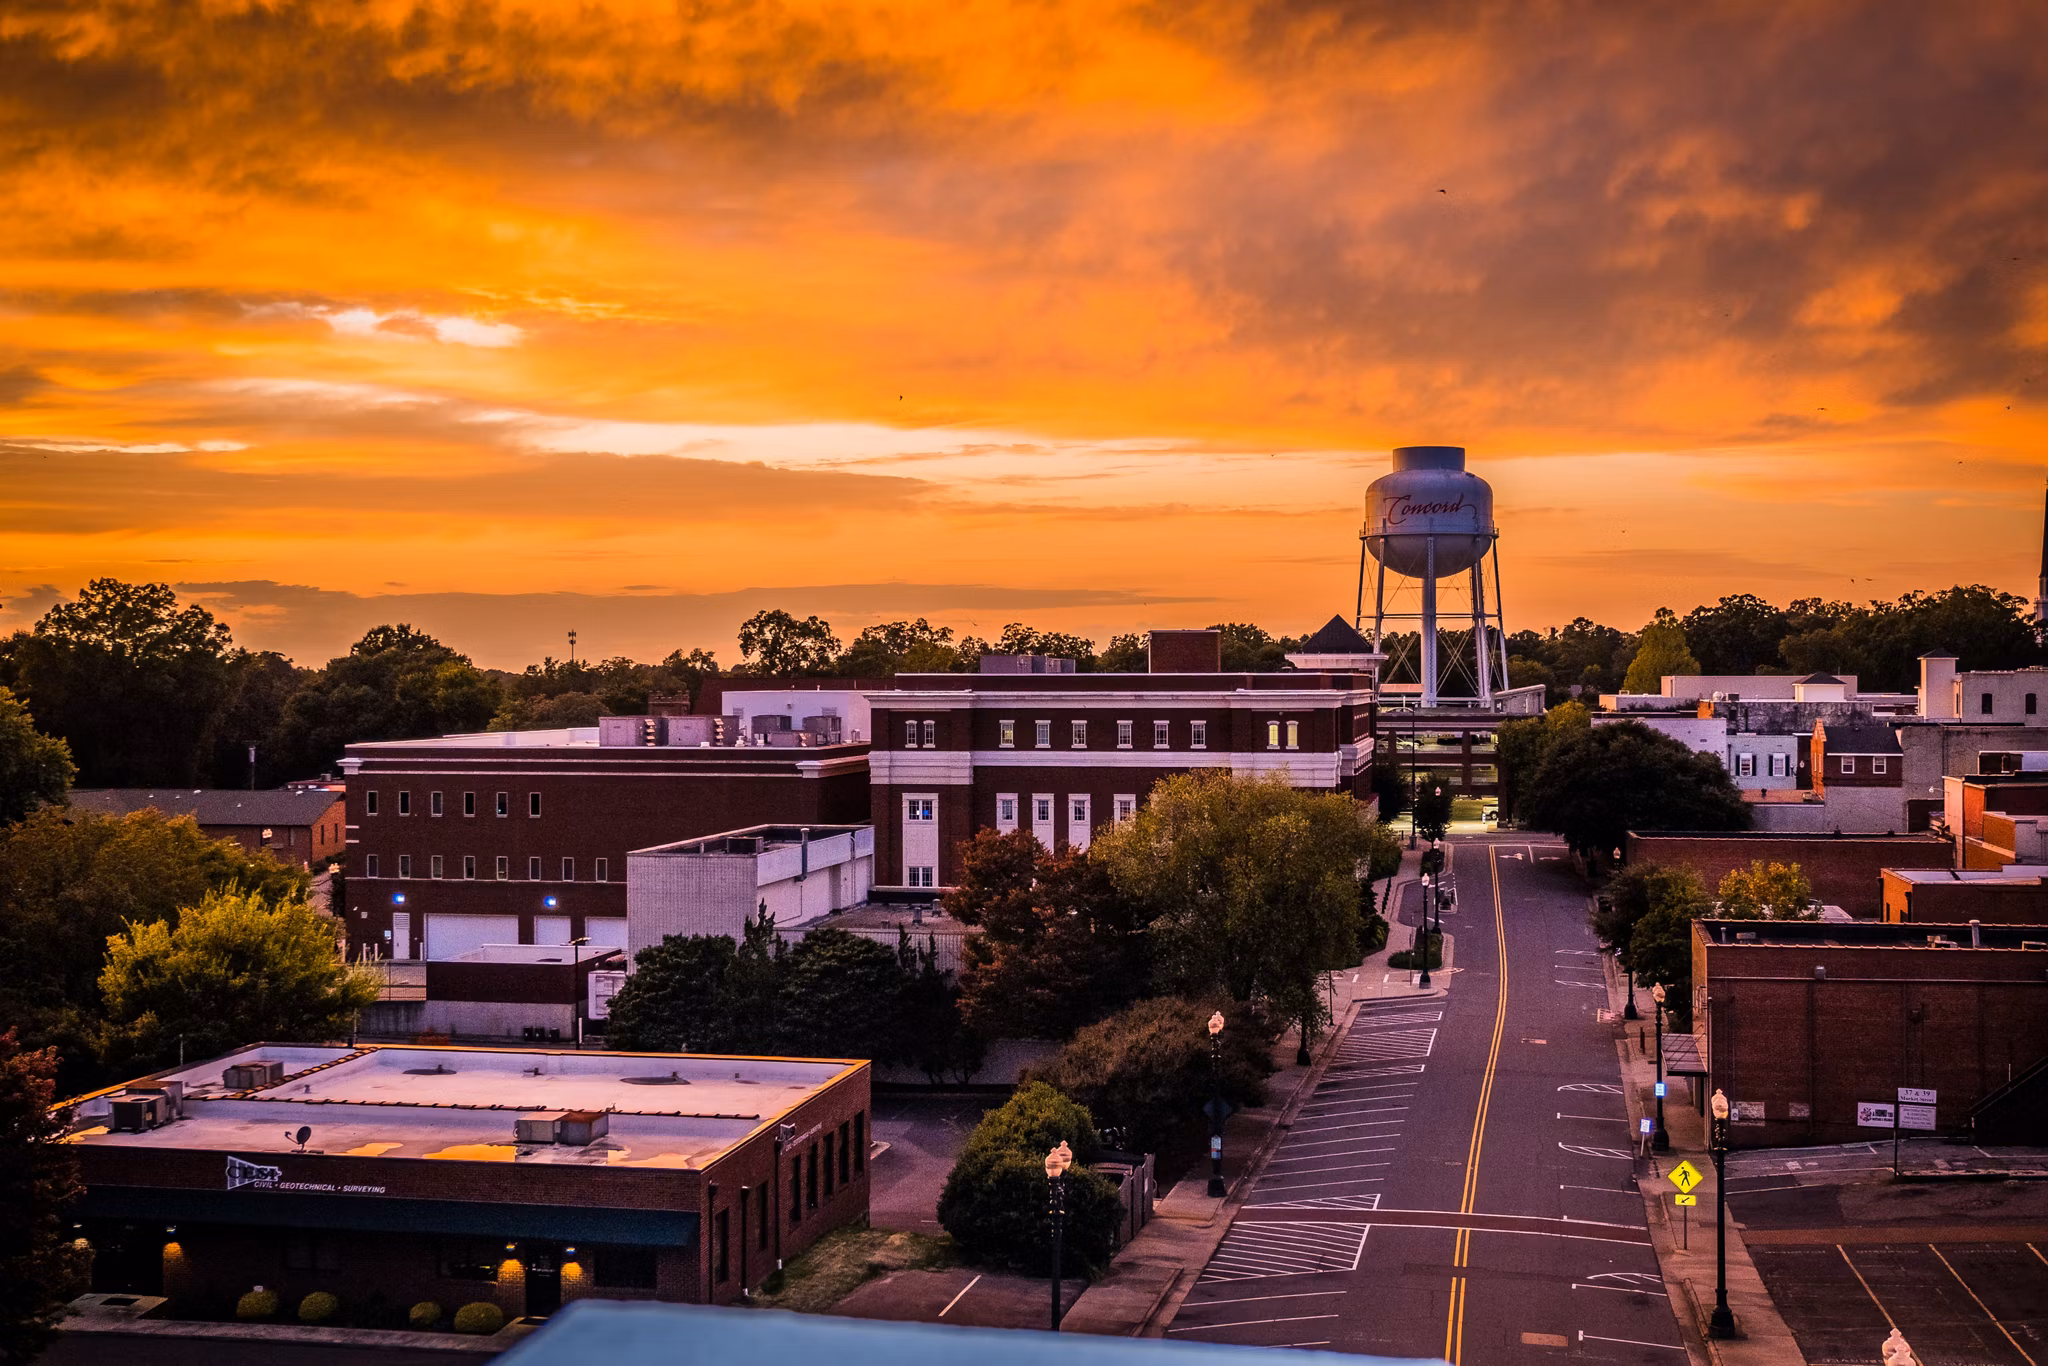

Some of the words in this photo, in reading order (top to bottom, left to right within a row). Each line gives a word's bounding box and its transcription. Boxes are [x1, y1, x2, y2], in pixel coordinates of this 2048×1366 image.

[1383, 493, 1478, 525] Concord
[253, 1181, 273, 1189] CIVIL
[279, 1182, 336, 1191] GEOTECHNICAL
[342, 1185, 386, 1193] SURVEYING
